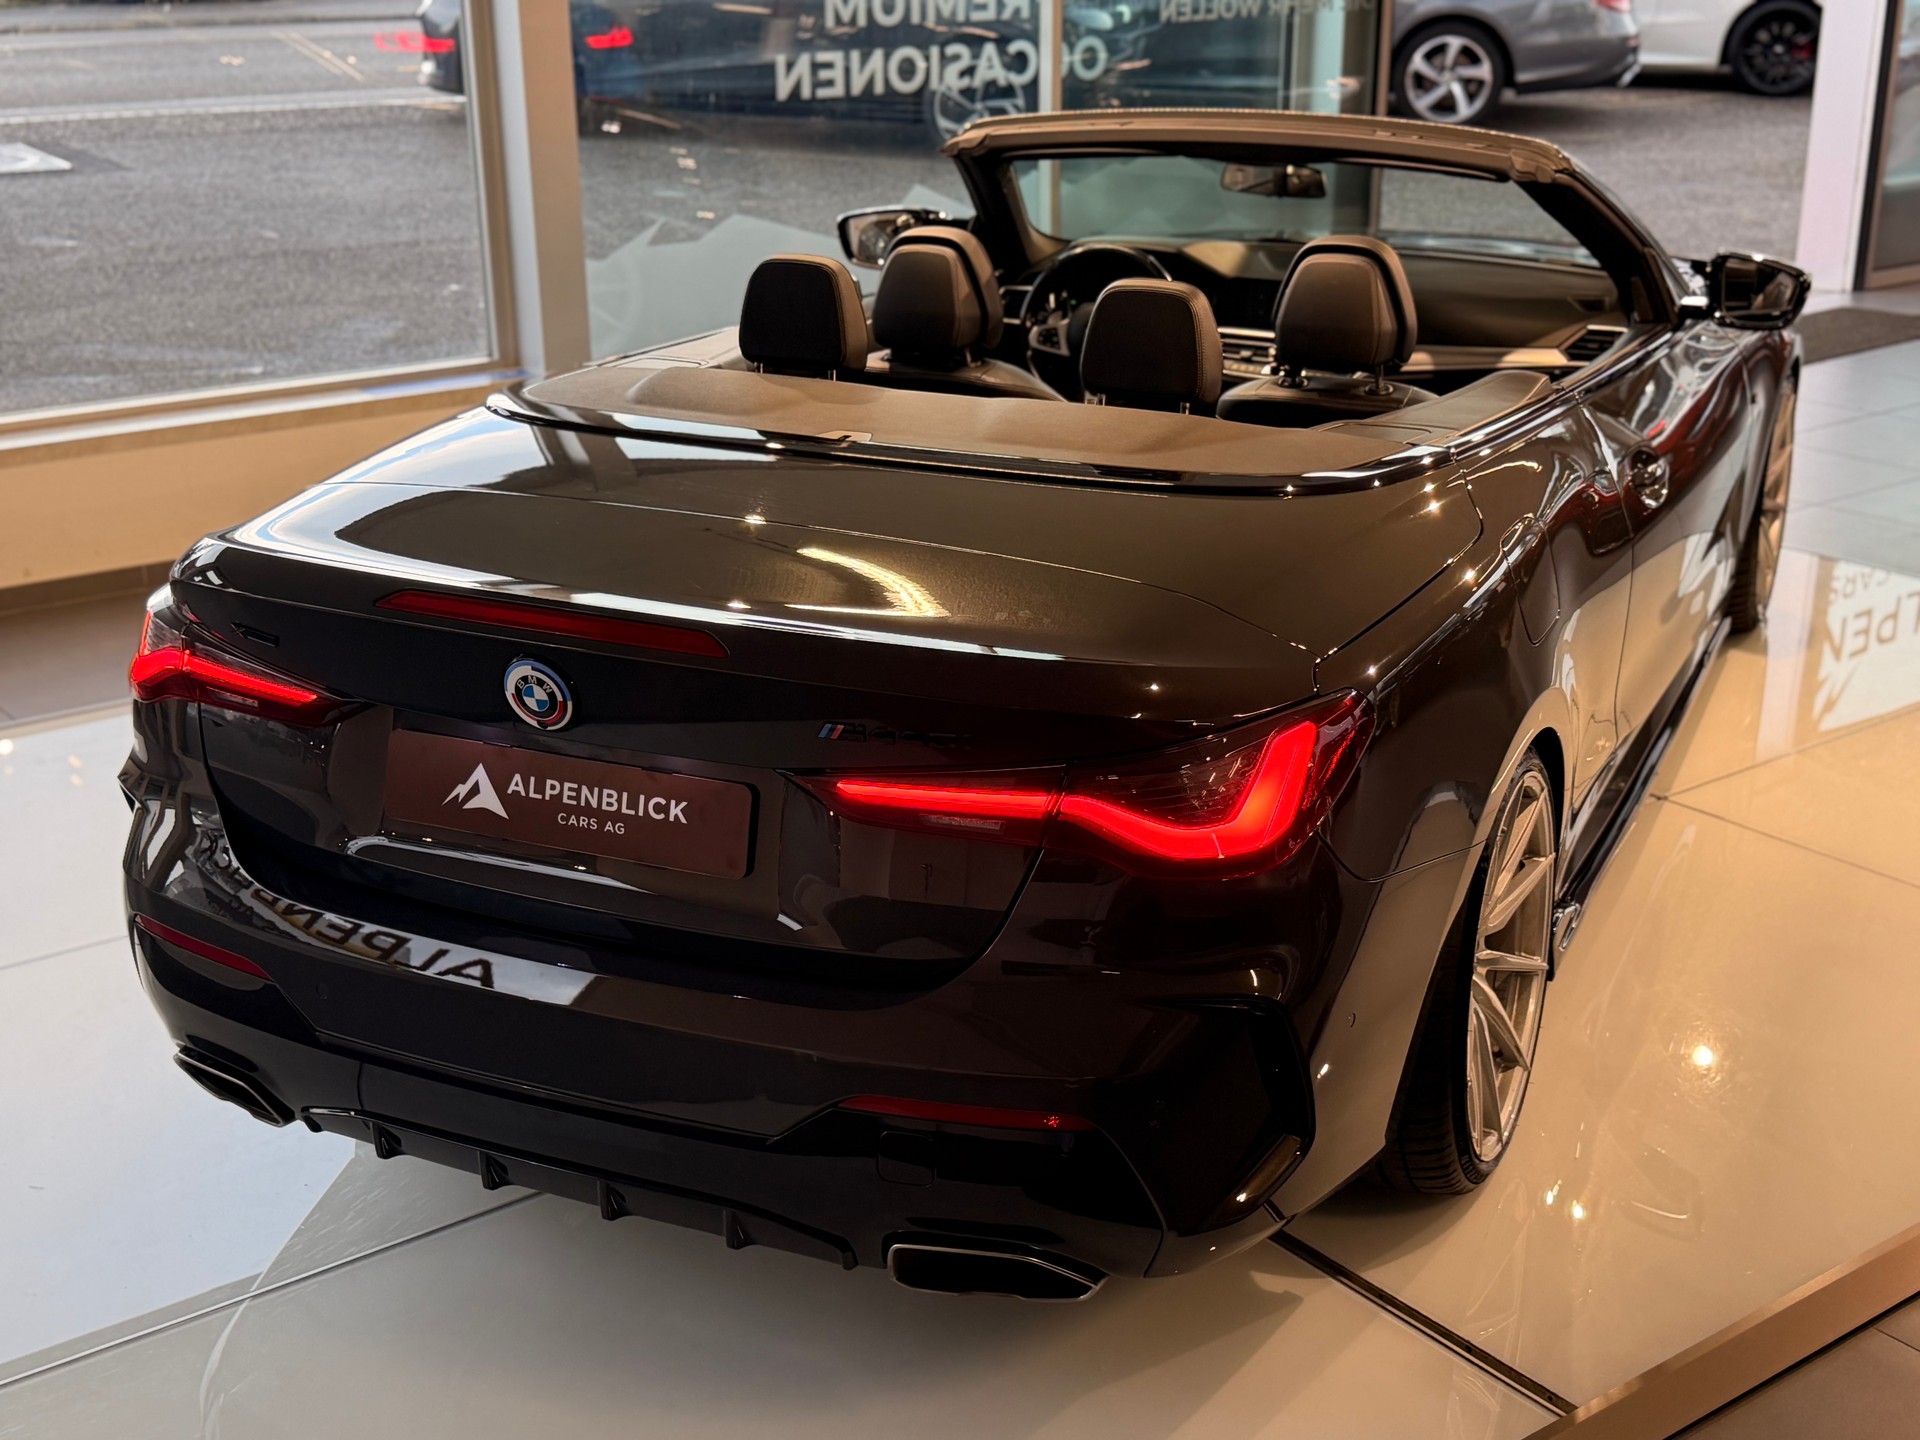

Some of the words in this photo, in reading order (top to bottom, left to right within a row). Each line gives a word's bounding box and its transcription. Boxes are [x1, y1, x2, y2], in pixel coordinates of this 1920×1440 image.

[516, 675, 553, 694] BMW
[507, 772, 689, 825] ALPENBLICK
[557, 812, 599, 831] CARS
[604, 819, 626, 836] AG
